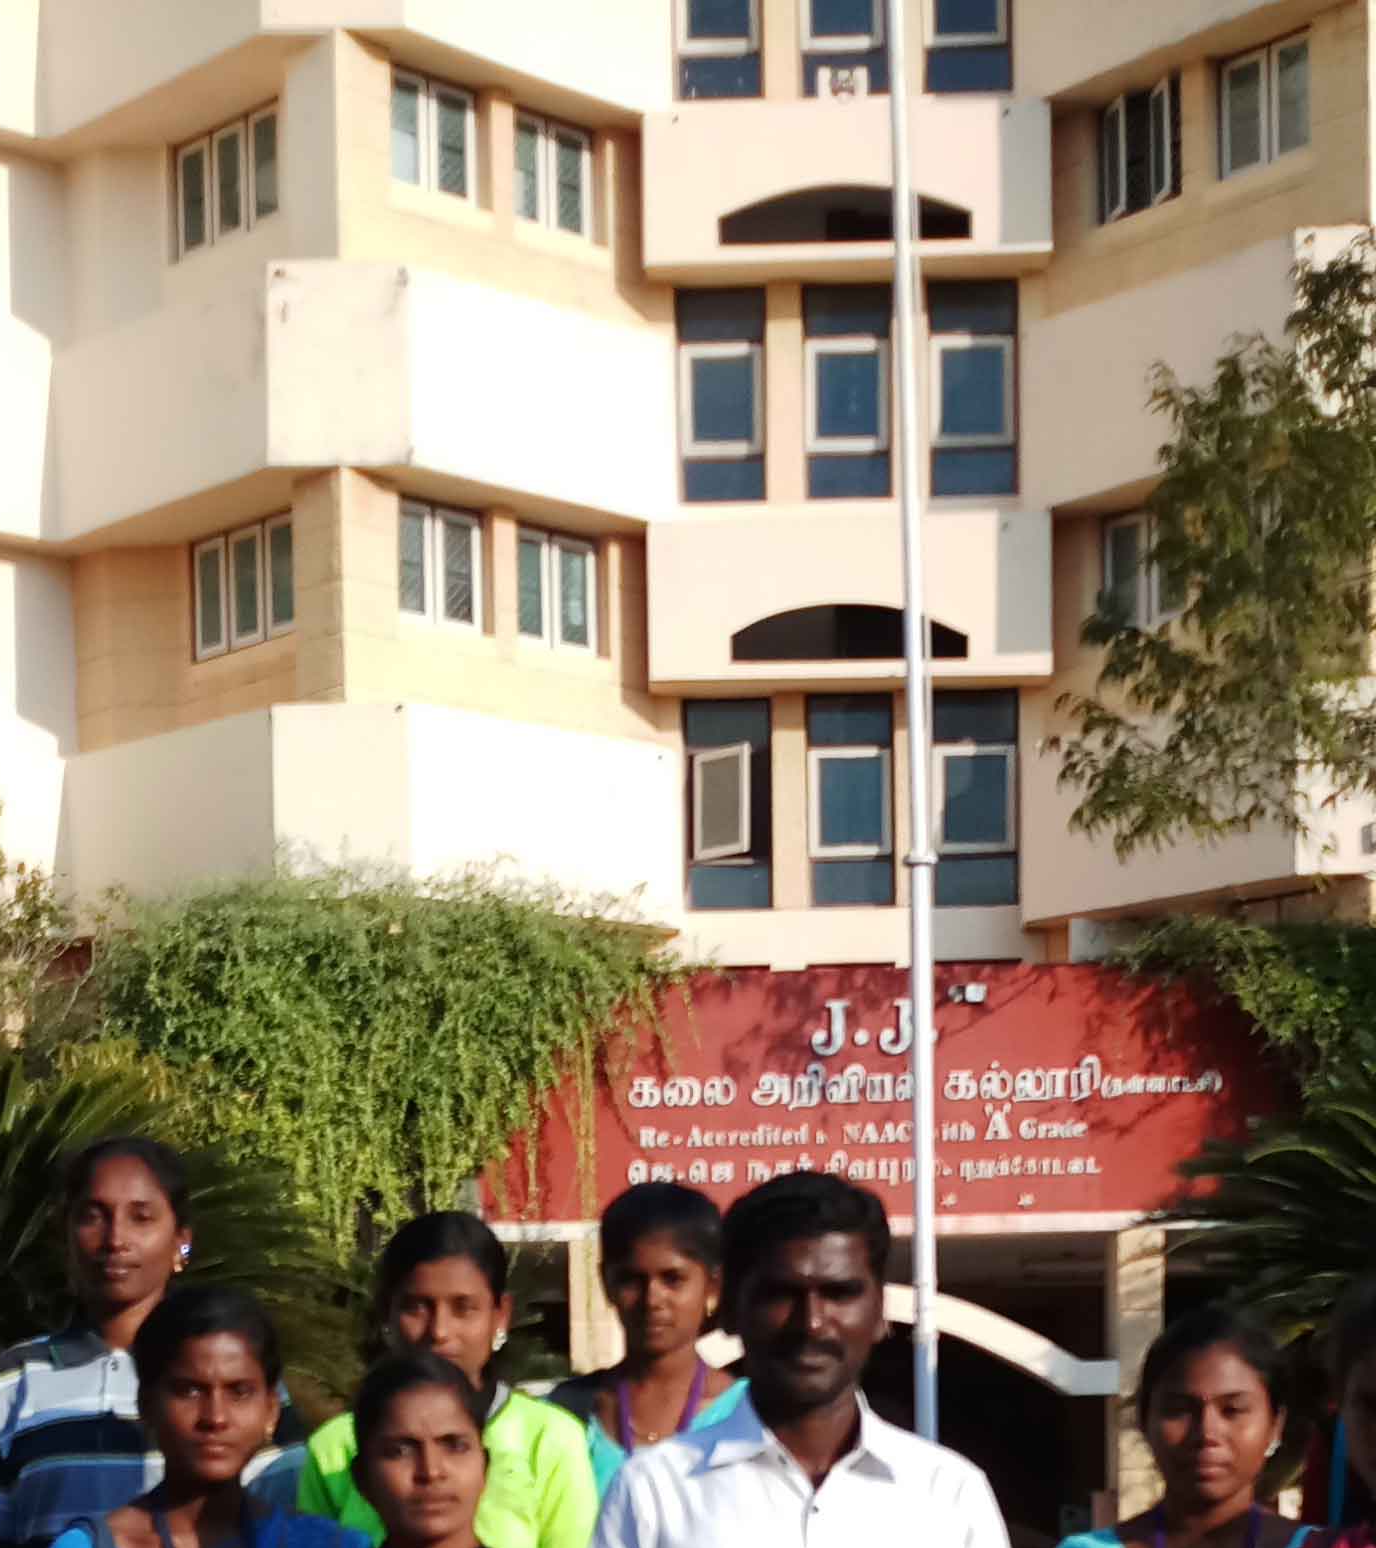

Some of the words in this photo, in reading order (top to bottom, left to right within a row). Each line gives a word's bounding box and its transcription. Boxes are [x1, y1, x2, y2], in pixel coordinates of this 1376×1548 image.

[627, 1075, 737, 1108] கலை
[843, 1120, 914, 1145] NAAC
[1018, 1118, 1089, 1140] Grade
